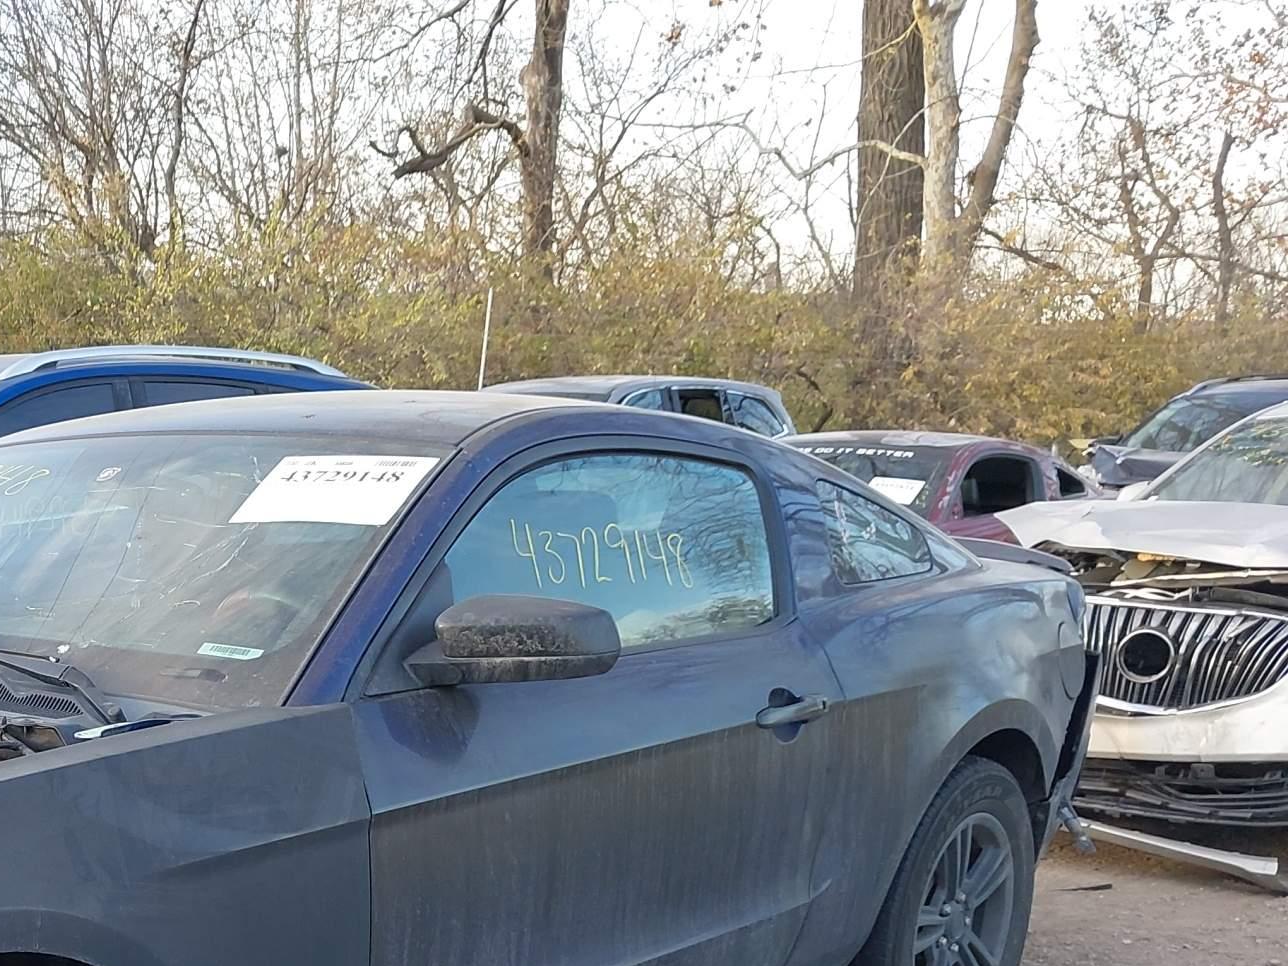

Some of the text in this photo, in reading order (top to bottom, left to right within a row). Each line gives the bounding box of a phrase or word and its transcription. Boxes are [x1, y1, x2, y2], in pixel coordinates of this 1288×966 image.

[855, 447, 915, 459] BETTER
[280, 470, 405, 483] 43729148
[510, 518, 694, 589] 43729148
